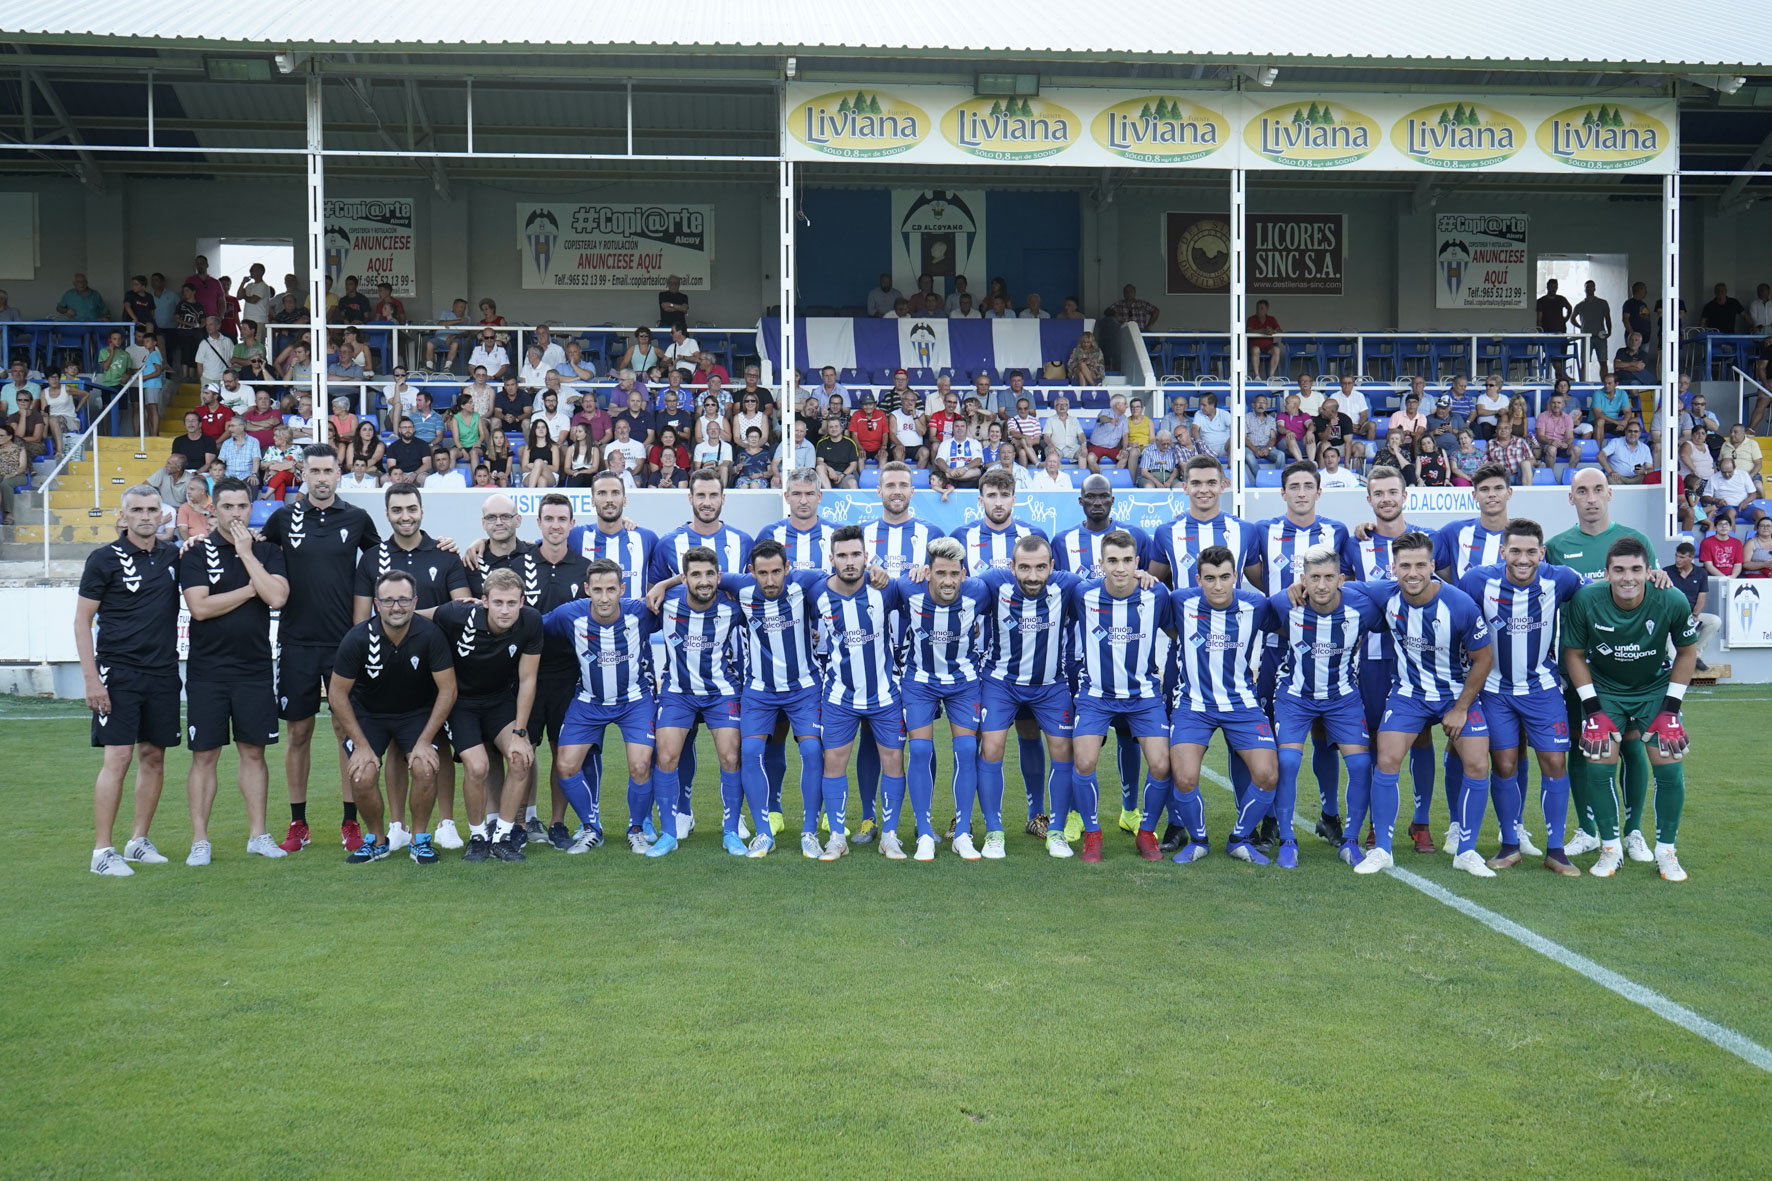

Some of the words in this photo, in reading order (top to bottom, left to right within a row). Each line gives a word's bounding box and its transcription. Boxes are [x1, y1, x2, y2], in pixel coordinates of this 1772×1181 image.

[806, 106, 918, 144] Liviana
[958, 110, 1069, 147] Liviana
[1108, 112, 1217, 149] Liviana
[1261, 118, 1369, 154] Liviana
[1408, 119, 1514, 155] Liviana
[1552, 120, 1658, 155] Liviana
[882, 147, 905, 156] SODIO
[1034, 149, 1056, 158] SODIO
[1182, 152, 1205, 160] SODIO
[1335, 156, 1357, 165] SODIO
[1480, 157, 1502, 166] SODIO
[1624, 158, 1645, 167] SODIO
[572, 207, 704, 237] #Copi@rte
[1438, 216, 1526, 235] #Copi@rte
[675, 236, 700, 245] Alcoy
[1256, 222, 1335, 250] LICORES
[353, 236, 411, 250] ANUNCIESE
[598, 240, 602, 250] Y
[603, 238, 638, 250] ROTULACIÓN
[578, 254, 634, 269] ANUNCIESE
[637, 248, 663, 272] AQUÍ
[1472, 250, 1525, 263] ANUNCIESE
[367, 253, 393, 275] AQUÍ
[1256, 252, 1299, 278] SINC
[1305, 252, 1340, 278] S.A.
[391, 276, 399, 286] 13
[401, 276, 409, 286] 99
[581, 274, 589, 286] 52
[590, 274, 598, 286] 13
[599, 274, 606, 286] 99
[1484, 266, 1508, 287] AQUÍ
[1496, 288, 1504, 298] 52
[1506, 288, 1512, 298] 13
[1514, 288, 1522, 298] 99
[1614, 643, 1640, 651] unión
[1614, 649, 1657, 660] alcoyana
[1064, 710, 1071, 723] 5
[1467, 710, 1483, 725] 18
[1256, 723, 1271, 736] 17
[1552, 720, 1567, 736] 16
